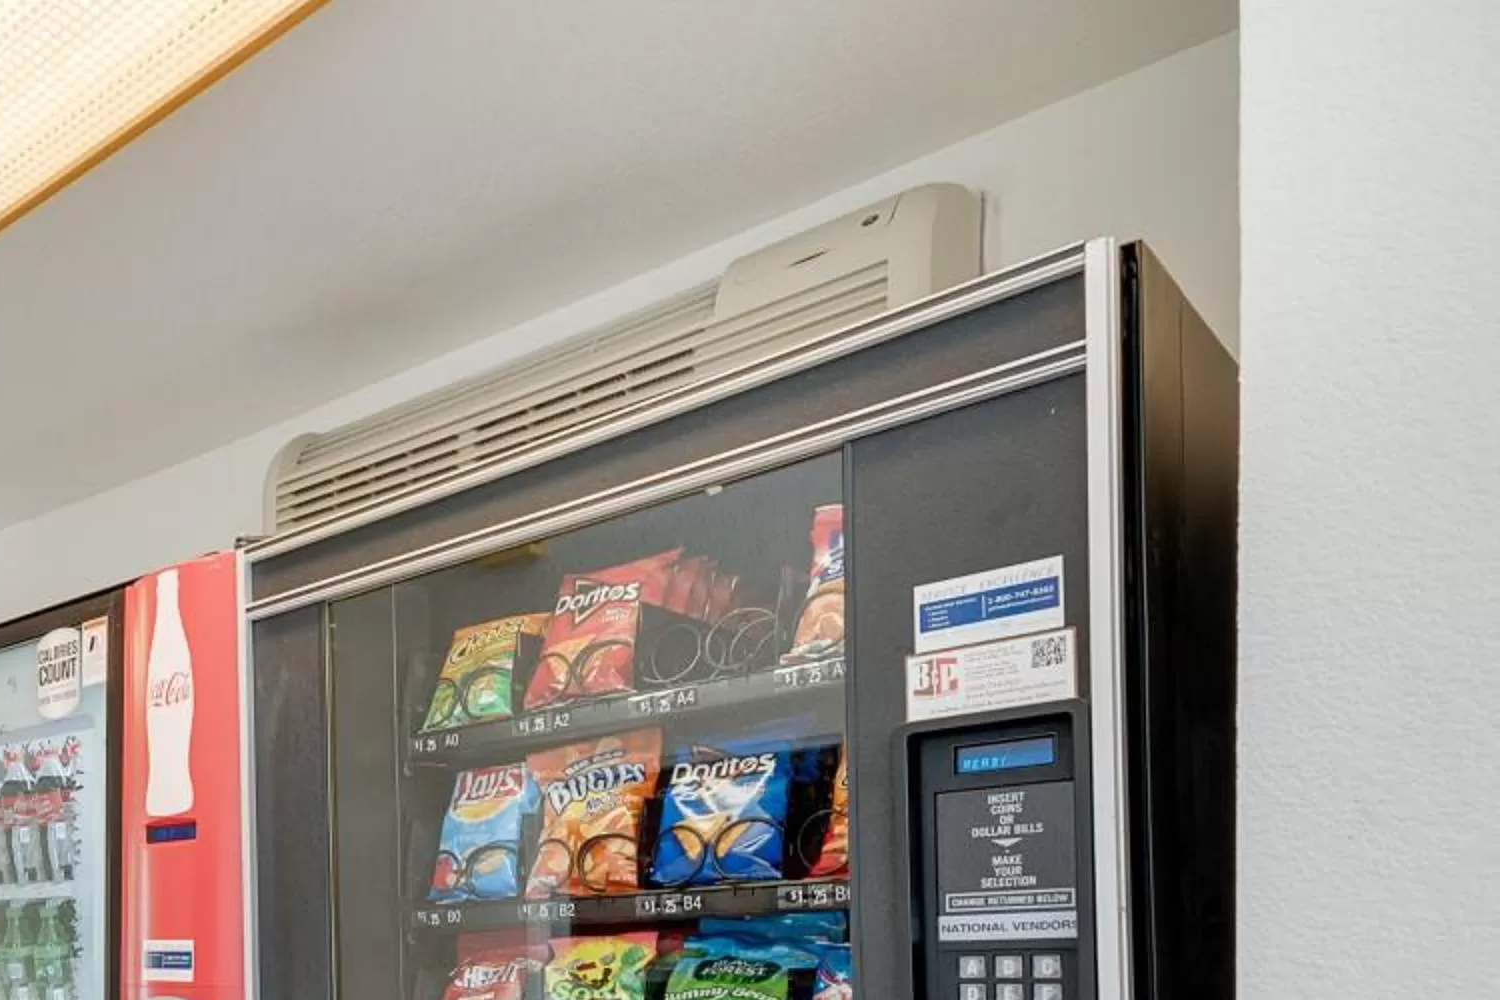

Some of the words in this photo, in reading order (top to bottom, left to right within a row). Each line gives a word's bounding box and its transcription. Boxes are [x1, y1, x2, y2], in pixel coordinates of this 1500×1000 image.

[555, 581, 640, 616] Doritos
[39, 657, 77, 687] COUNT
[832, 661, 846, 677] A
[677, 690, 696, 705] A4
[554, 713, 570, 728] A2
[669, 752, 777, 785] Doritos
[547, 763, 646, 816] BUGLES
[987, 791, 1025, 805] INSERT
[990, 804, 1023, 816] COINS
[971, 825, 1011, 838] DOLLAR
[1013, 822, 1044, 835] BILLS
[991, 853, 1023, 866] MAKE
[993, 865, 1023, 877] YOUR
[980, 875, 1037, 889] SELECTION
[560, 903, 576, 918] B2
[683, 896, 701, 911] B4
[941, 921, 1006, 933] NATIONAL
